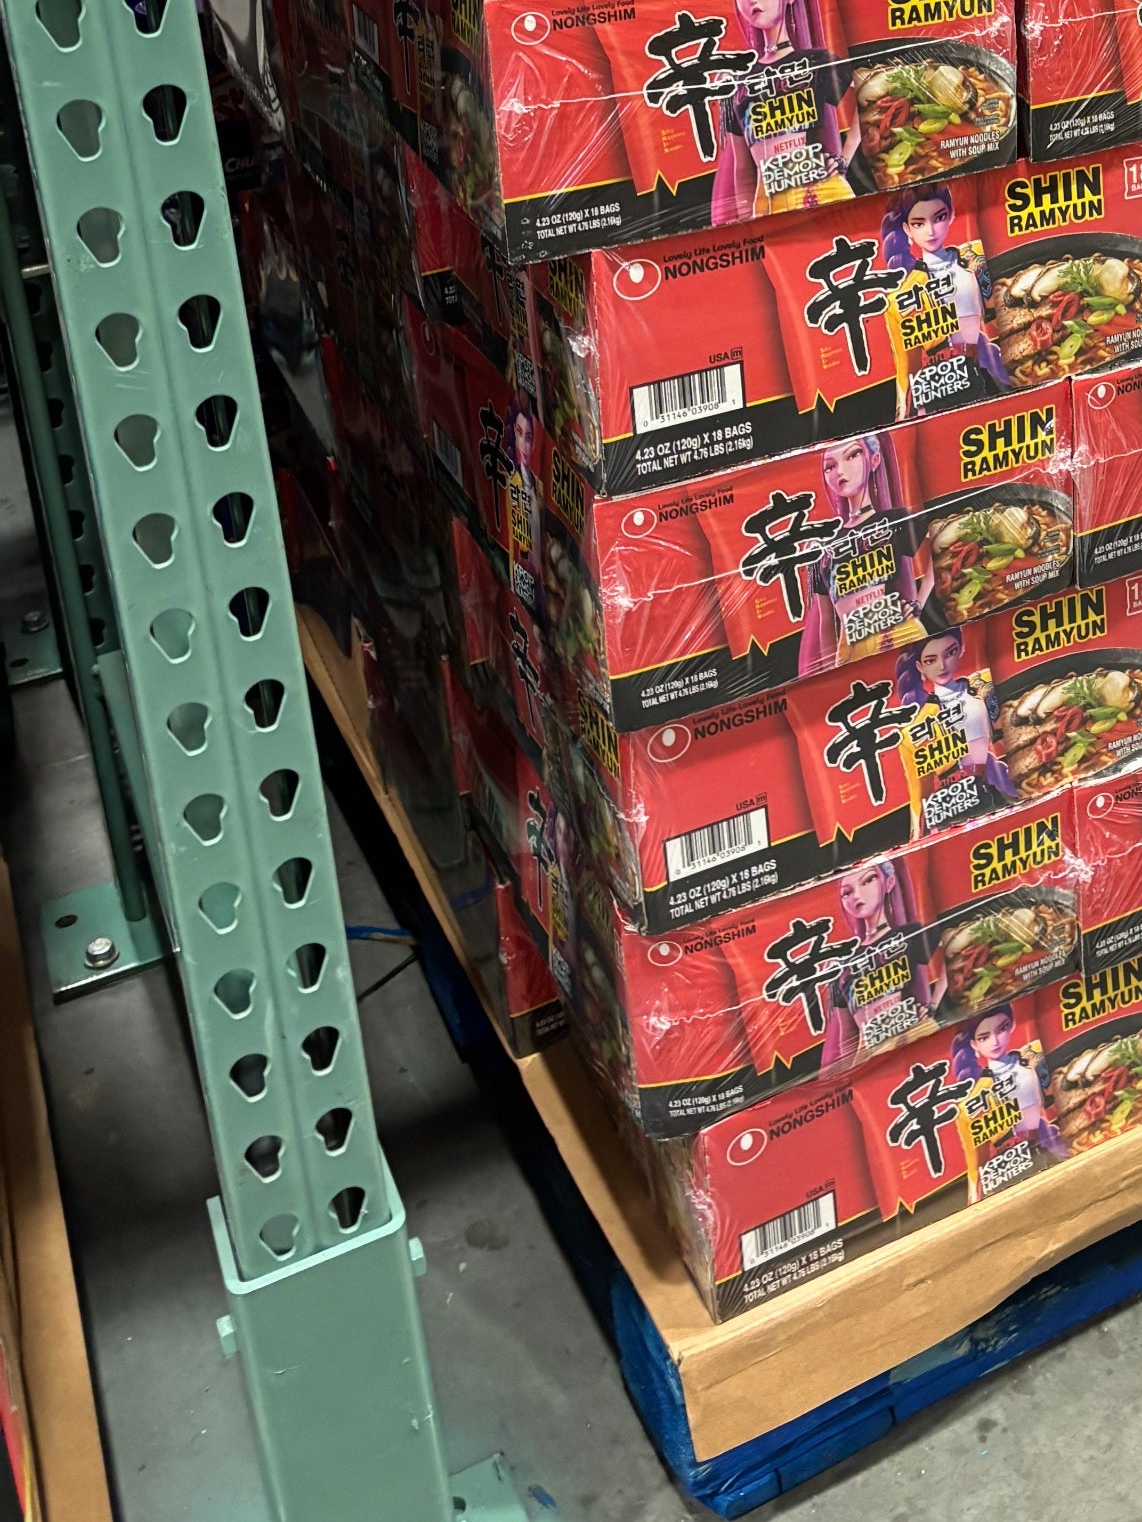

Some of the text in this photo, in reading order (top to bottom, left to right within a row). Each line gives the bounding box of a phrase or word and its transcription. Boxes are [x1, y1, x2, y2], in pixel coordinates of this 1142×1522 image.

[551, 8, 636, 30] NONGSHIM
[645, 10, 757, 162] 辛
[773, 136, 807, 154] NETFLIX
[1006, 165, 1103, 211] SHIN
[1006, 199, 1103, 234] RAMYUN
[663, 245, 766, 281] NONGSHIM
[805, 235, 905, 376] 辛
[741, 490, 841, 622] 辛
[1013, 588, 1107, 640] SHIN
[692, 699, 789, 741] NONGSHIM
[768, 1088, 855, 1142] NONGSHIM
[888, 1059, 974, 1178] 辛
